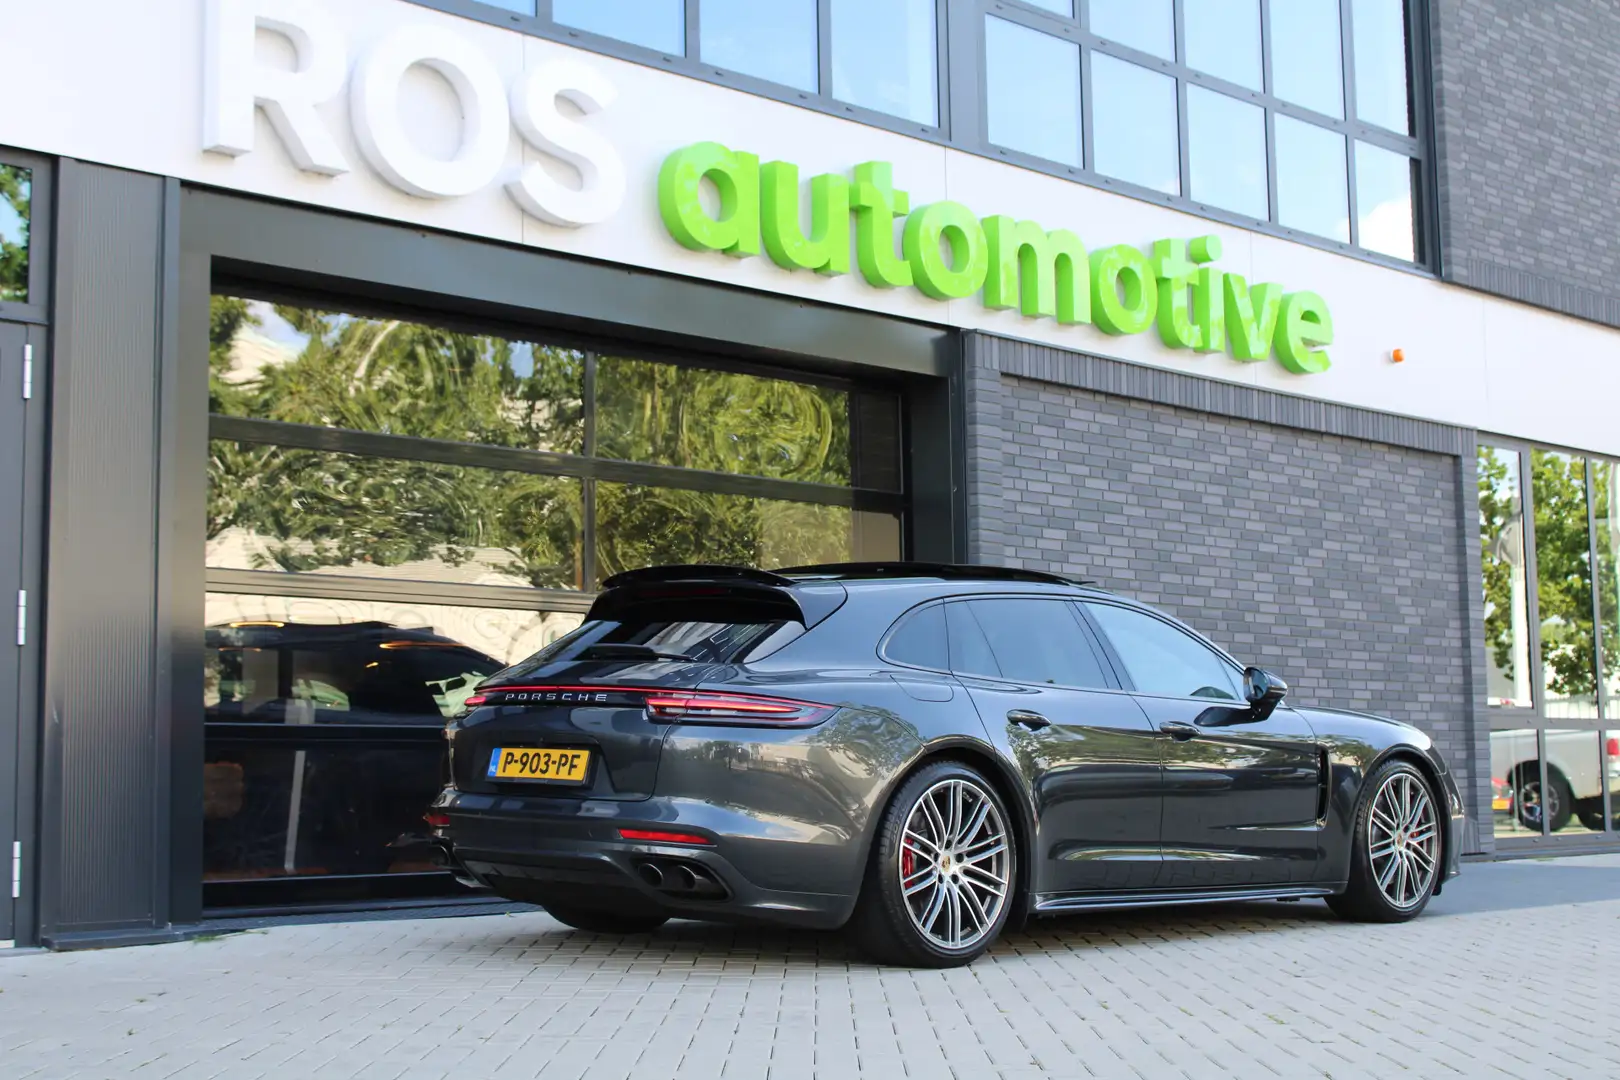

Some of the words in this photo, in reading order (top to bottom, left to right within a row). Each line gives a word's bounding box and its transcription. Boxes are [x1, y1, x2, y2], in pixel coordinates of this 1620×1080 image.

[202, 0, 627, 226] ROS
[658, 141, 1334, 374] automotive
[505, 692, 608, 702] PORSCHE
[502, 751, 582, 776] P-903-PF
